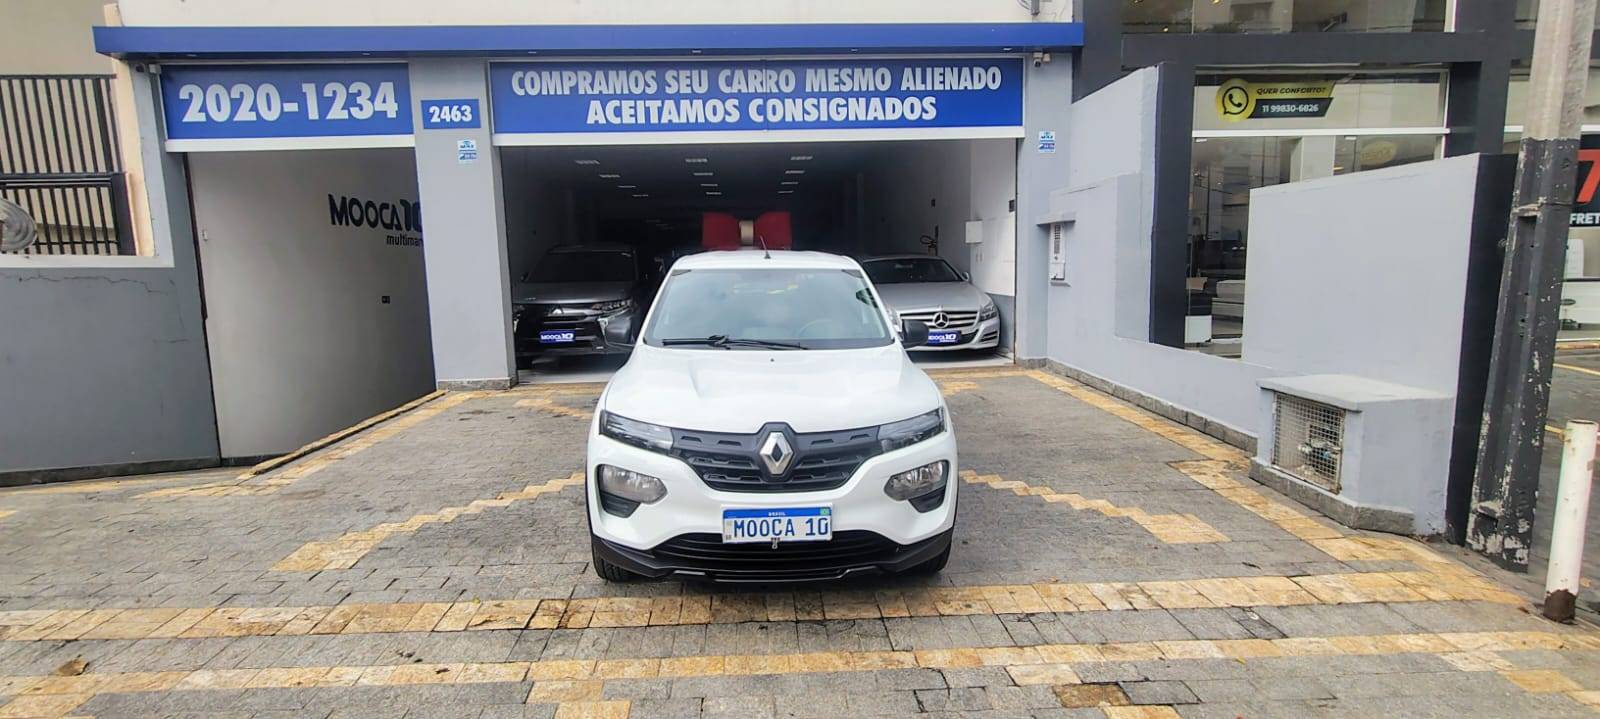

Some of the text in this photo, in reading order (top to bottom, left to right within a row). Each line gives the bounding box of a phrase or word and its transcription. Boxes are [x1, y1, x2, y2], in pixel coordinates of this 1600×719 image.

[511, 66, 1002, 96] COMPRAMOS SEU CARRO MESMO ALIENADO
[1256, 87, 1278, 95] QUER
[179, 81, 398, 122] 2020-1234
[586, 96, 937, 124] ACEITAMOS CONSIGNADOS
[1262, 104, 1269, 113] 11
[429, 105, 473, 123] 2463
[734, 519, 795, 537] MOOCA
